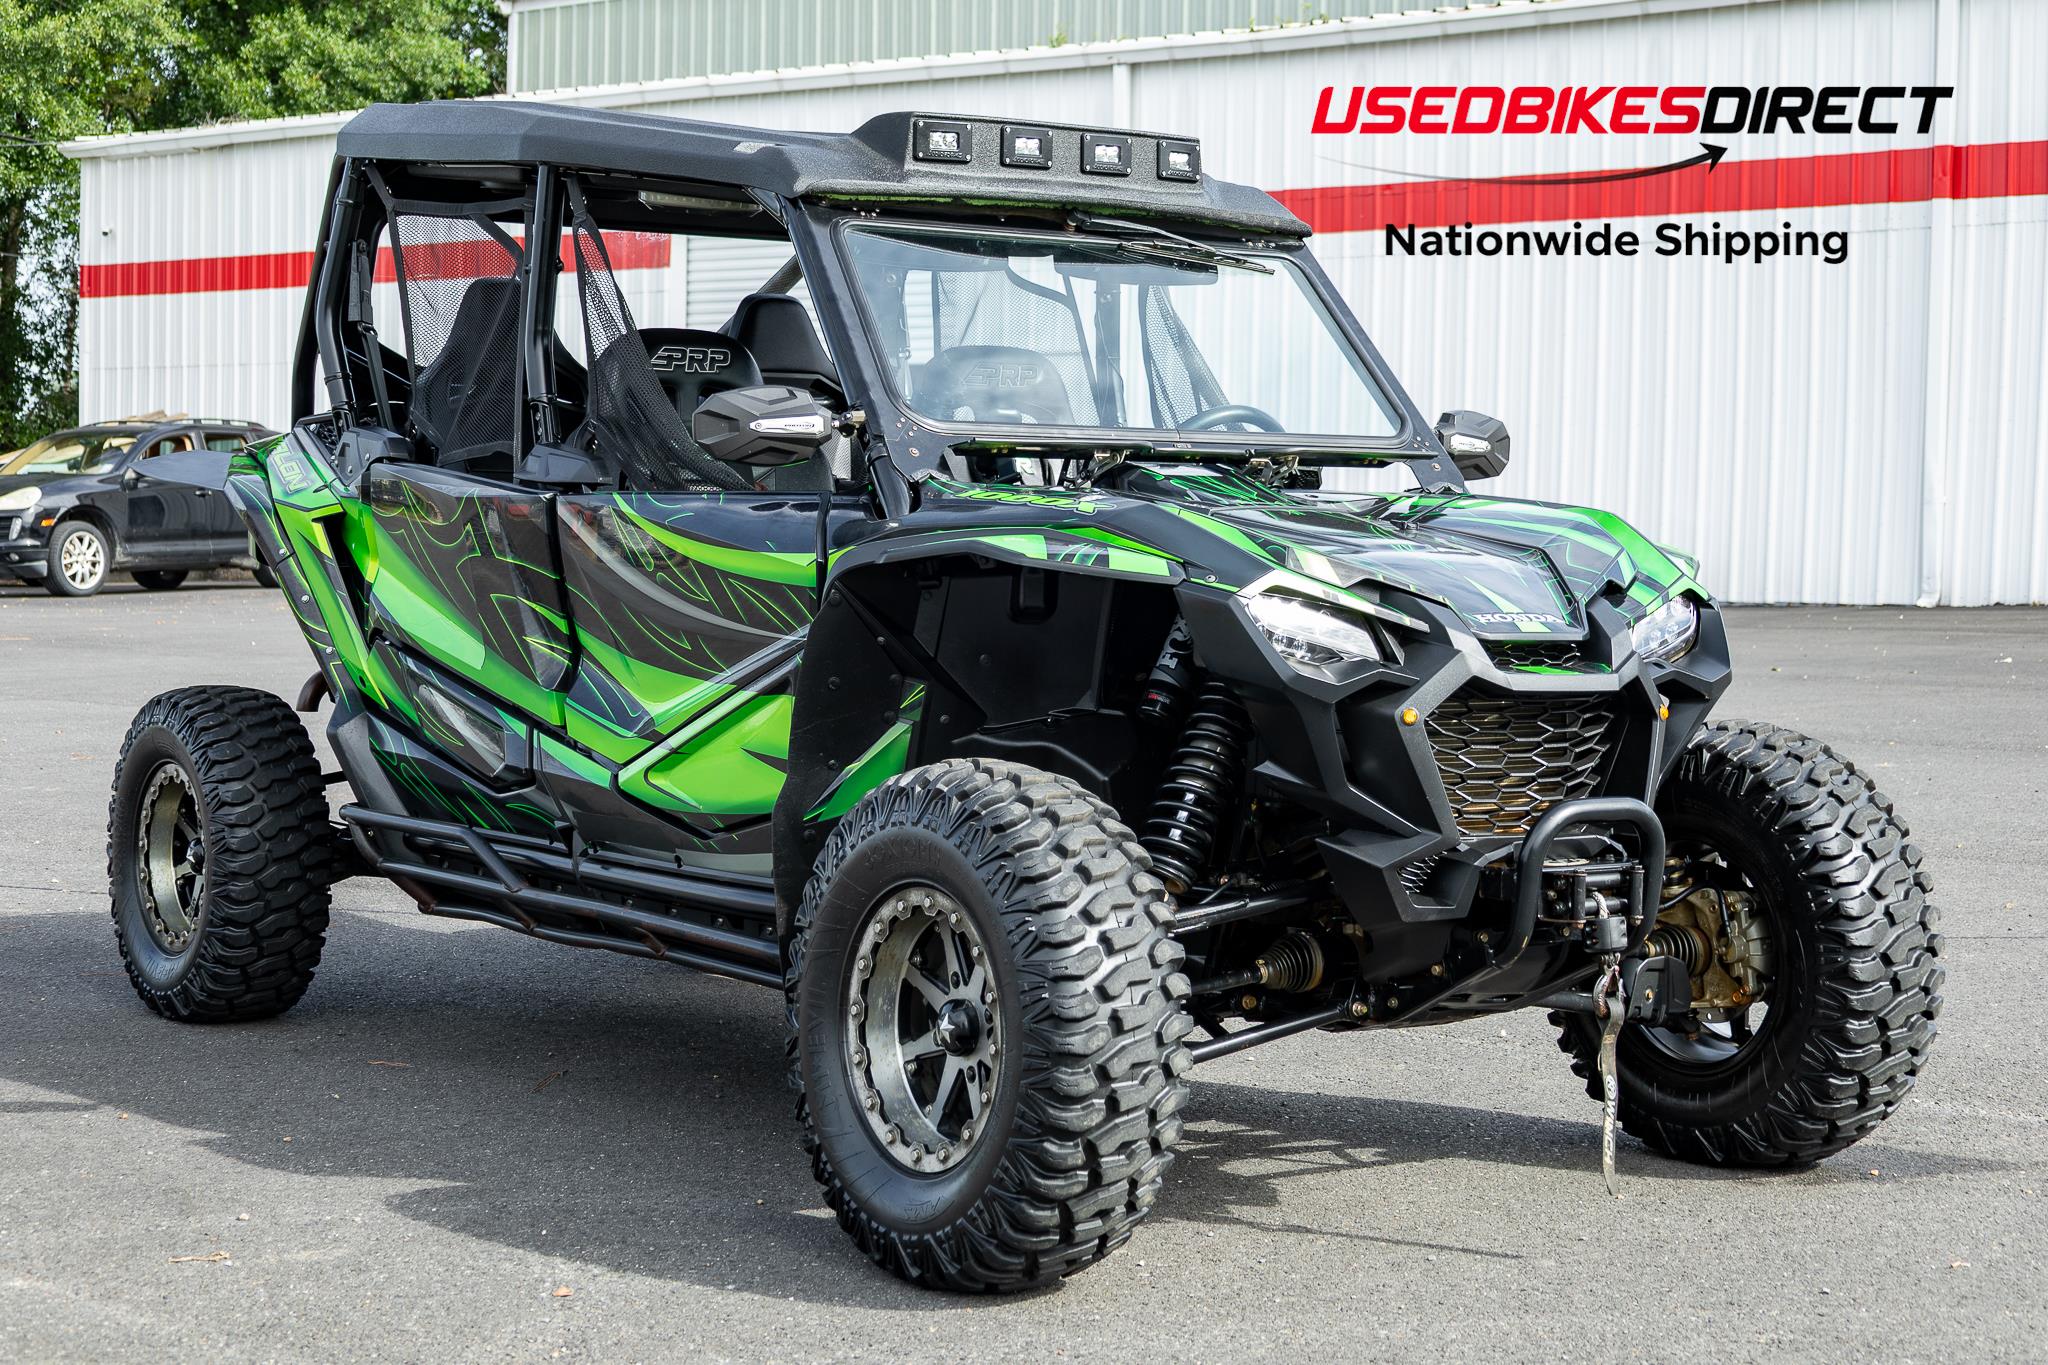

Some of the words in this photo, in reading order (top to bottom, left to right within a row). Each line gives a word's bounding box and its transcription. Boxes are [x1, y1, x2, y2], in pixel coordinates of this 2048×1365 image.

[652, 346, 730, 373] PRP
[961, 361, 1040, 388] PRP
[1472, 613, 1565, 623] HONDA
[1155, 613, 1192, 669] FOX
[1605, 1100, 1616, 1164] WINCH
